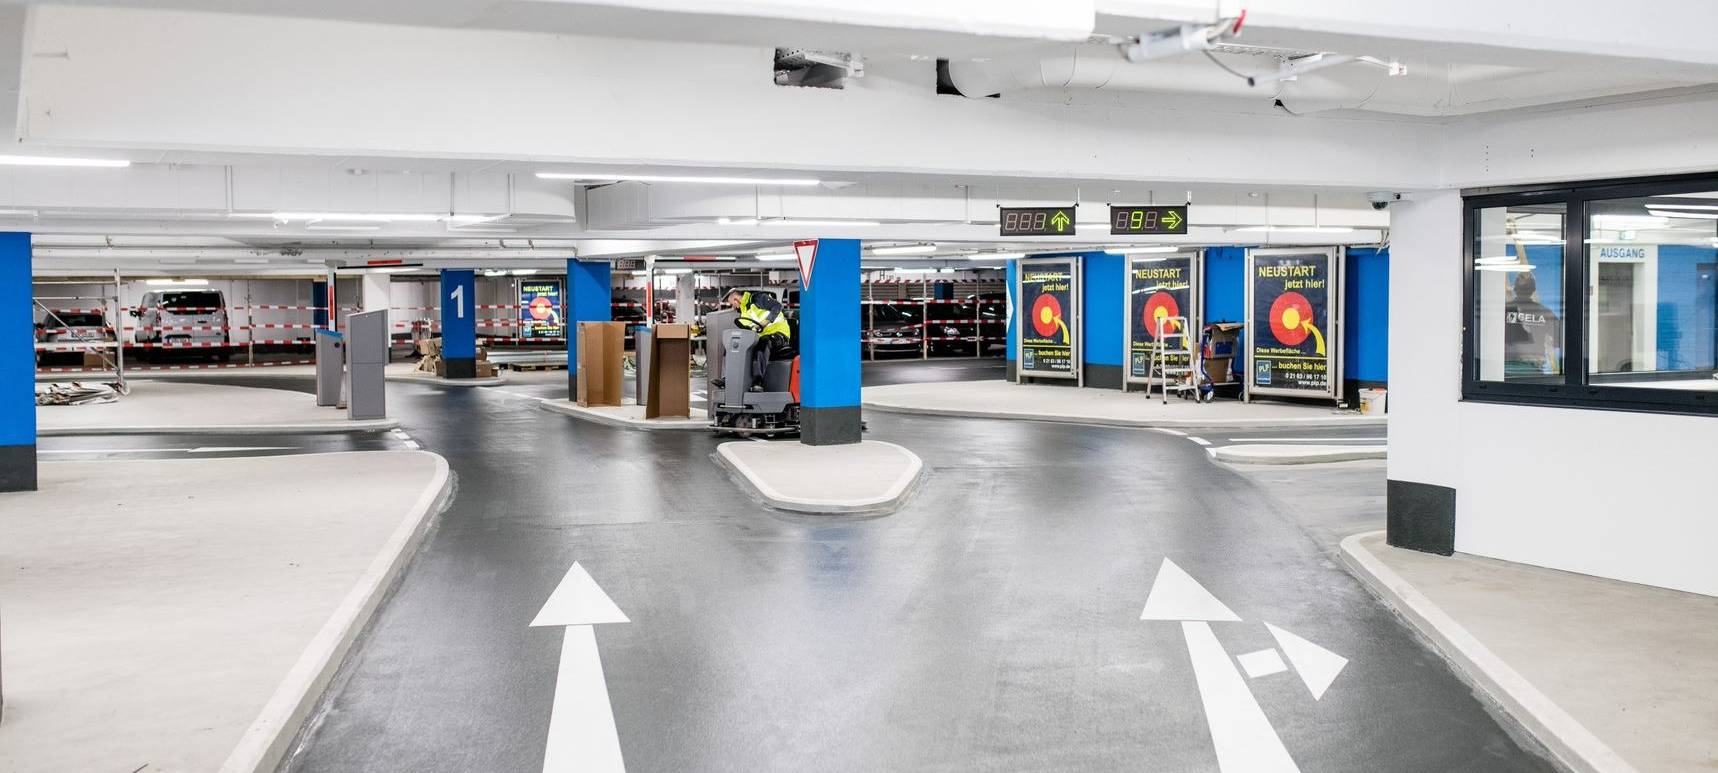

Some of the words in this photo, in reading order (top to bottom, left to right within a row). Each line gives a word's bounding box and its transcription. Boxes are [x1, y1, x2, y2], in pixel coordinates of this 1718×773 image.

[1600, 247, 1646, 259] AUSGANG
[1135, 268, 1181, 279] NEUSTART
[1259, 265, 1316, 277] NEUSTART
[1284, 279, 1303, 291] jetzt
[1305, 279, 1325, 288] hier!
[450, 284, 464, 318] 1
[1278, 361, 1302, 369] buchen
[1302, 362, 1313, 370] Sie
[1313, 363, 1326, 371] hier
